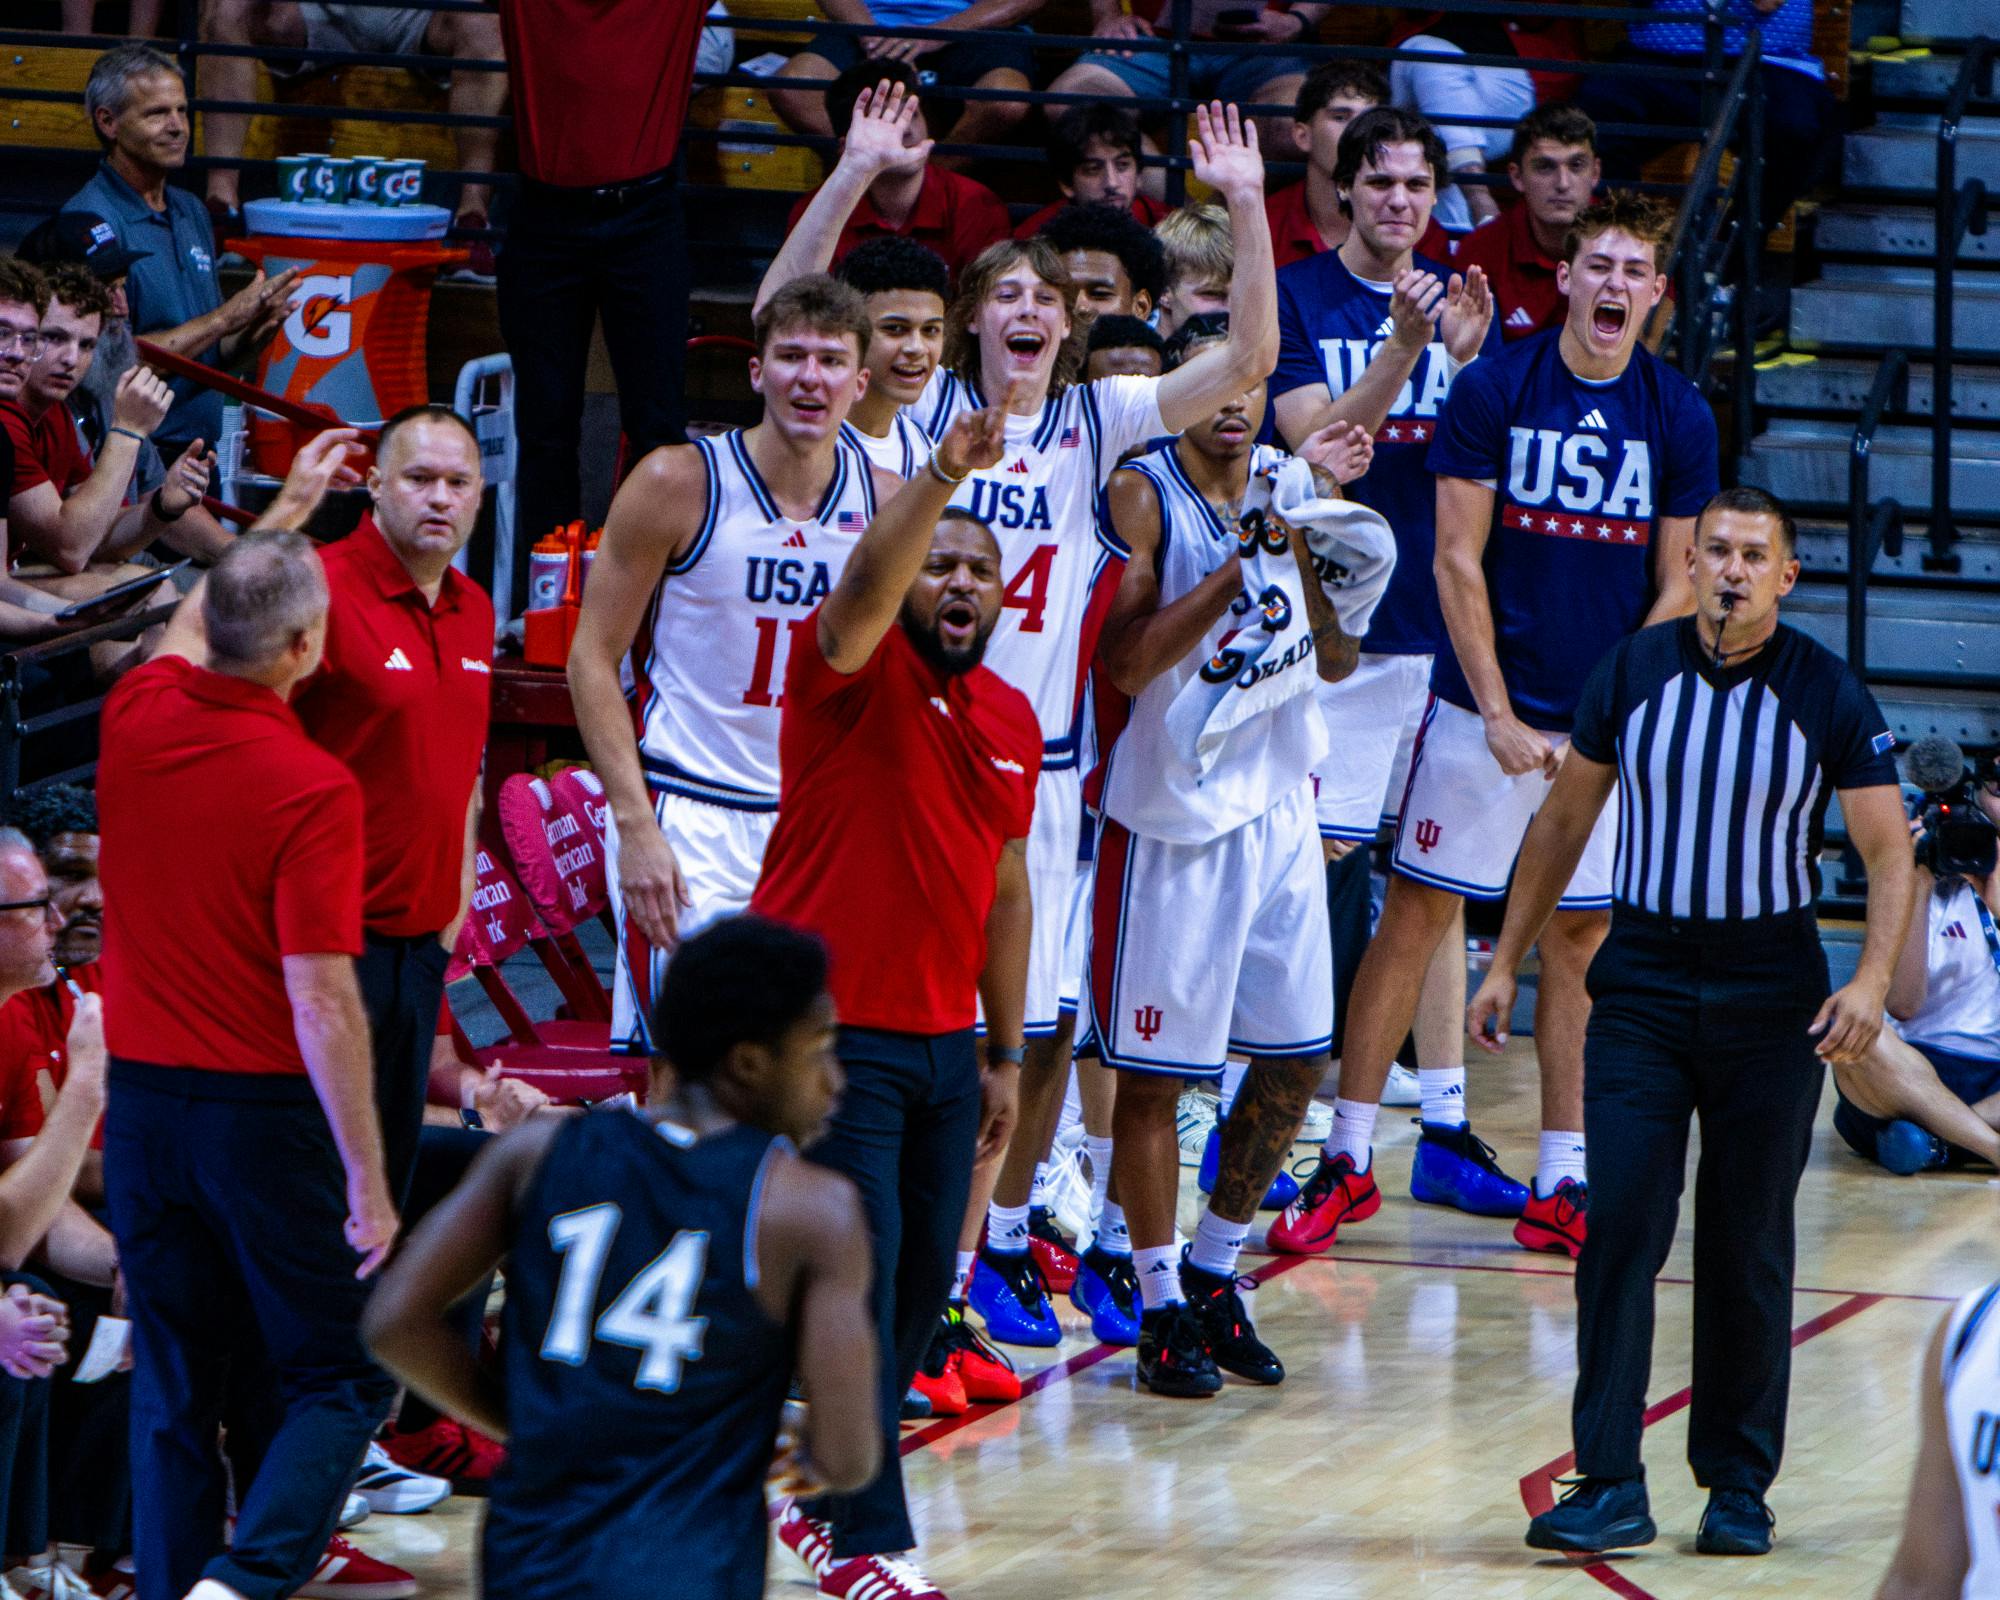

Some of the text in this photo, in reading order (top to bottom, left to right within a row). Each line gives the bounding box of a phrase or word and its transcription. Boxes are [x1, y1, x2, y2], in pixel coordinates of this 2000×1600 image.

[283, 275, 351, 357] G
[971, 478, 1052, 530] USA
[1509, 426, 1652, 517] USA
[745, 556, 830, 606] USA
[1002, 544, 1058, 633] 4
[539, 1201, 711, 1394] 14
